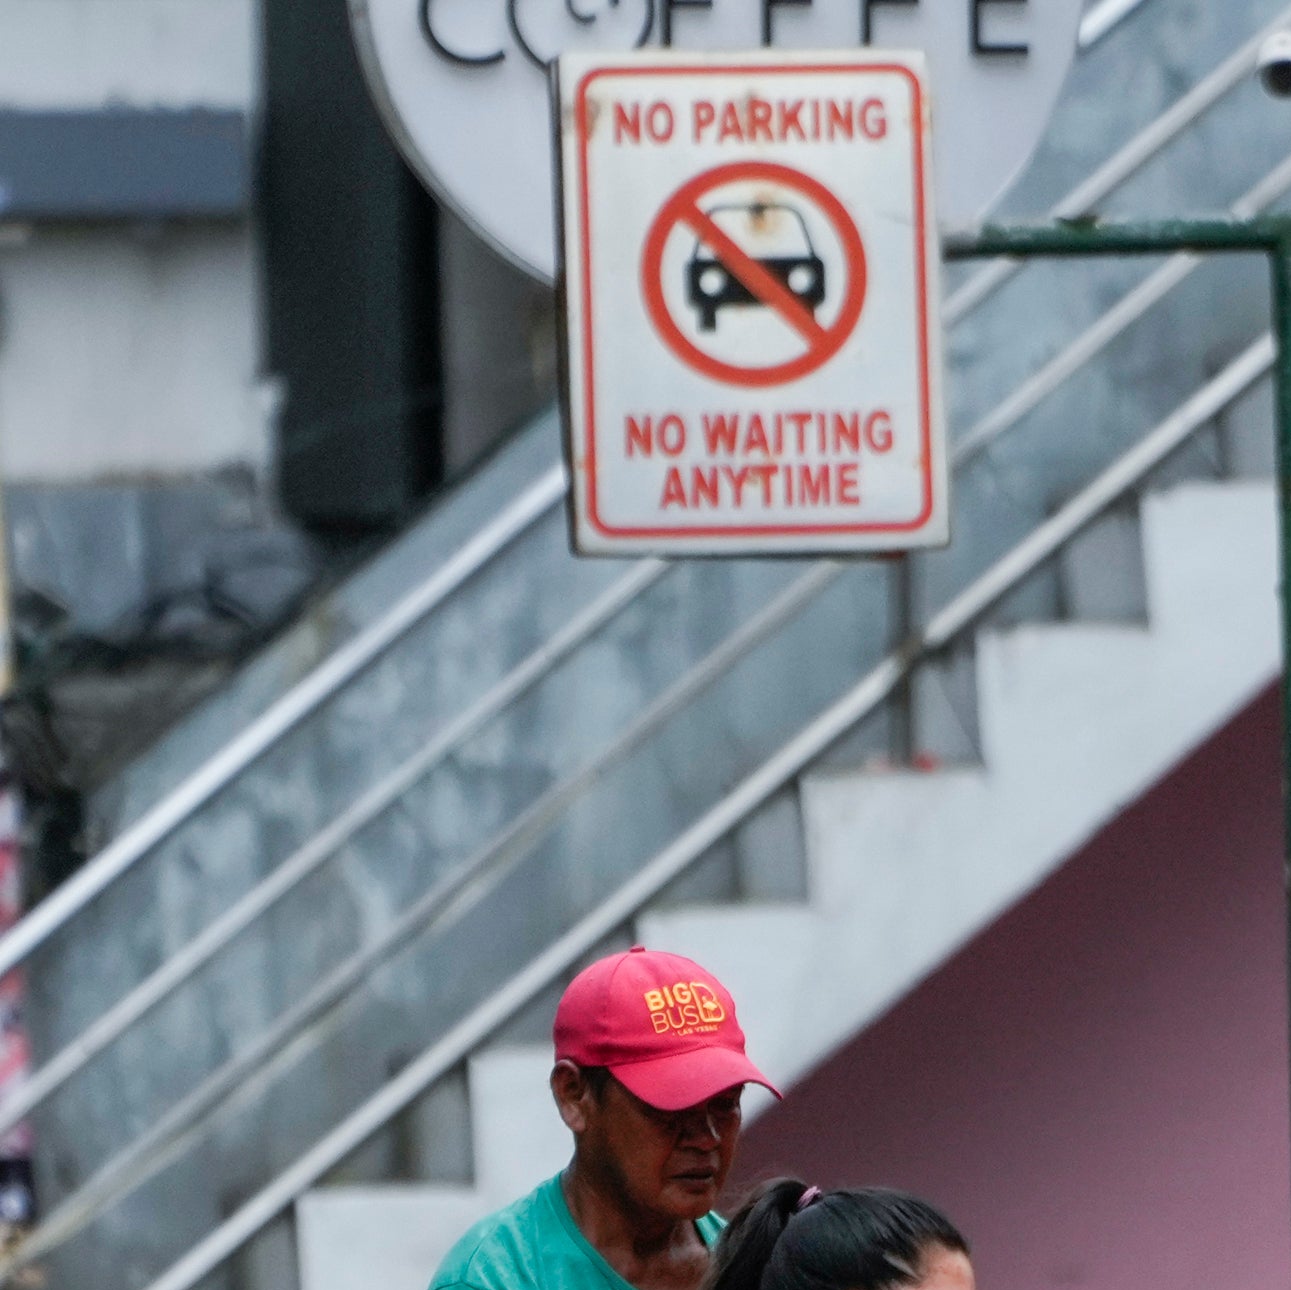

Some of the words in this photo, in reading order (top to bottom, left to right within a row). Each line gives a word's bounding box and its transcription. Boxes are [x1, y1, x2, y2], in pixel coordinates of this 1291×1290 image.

[613, 101, 675, 145] NO
[693, 97, 888, 144] PARKING
[624, 413, 686, 458] NO
[702, 410, 893, 456] WAITING
[659, 462, 860, 510] ANYTIME
[644, 981, 692, 1012] BIG
[650, 1004, 700, 1034] BUS
